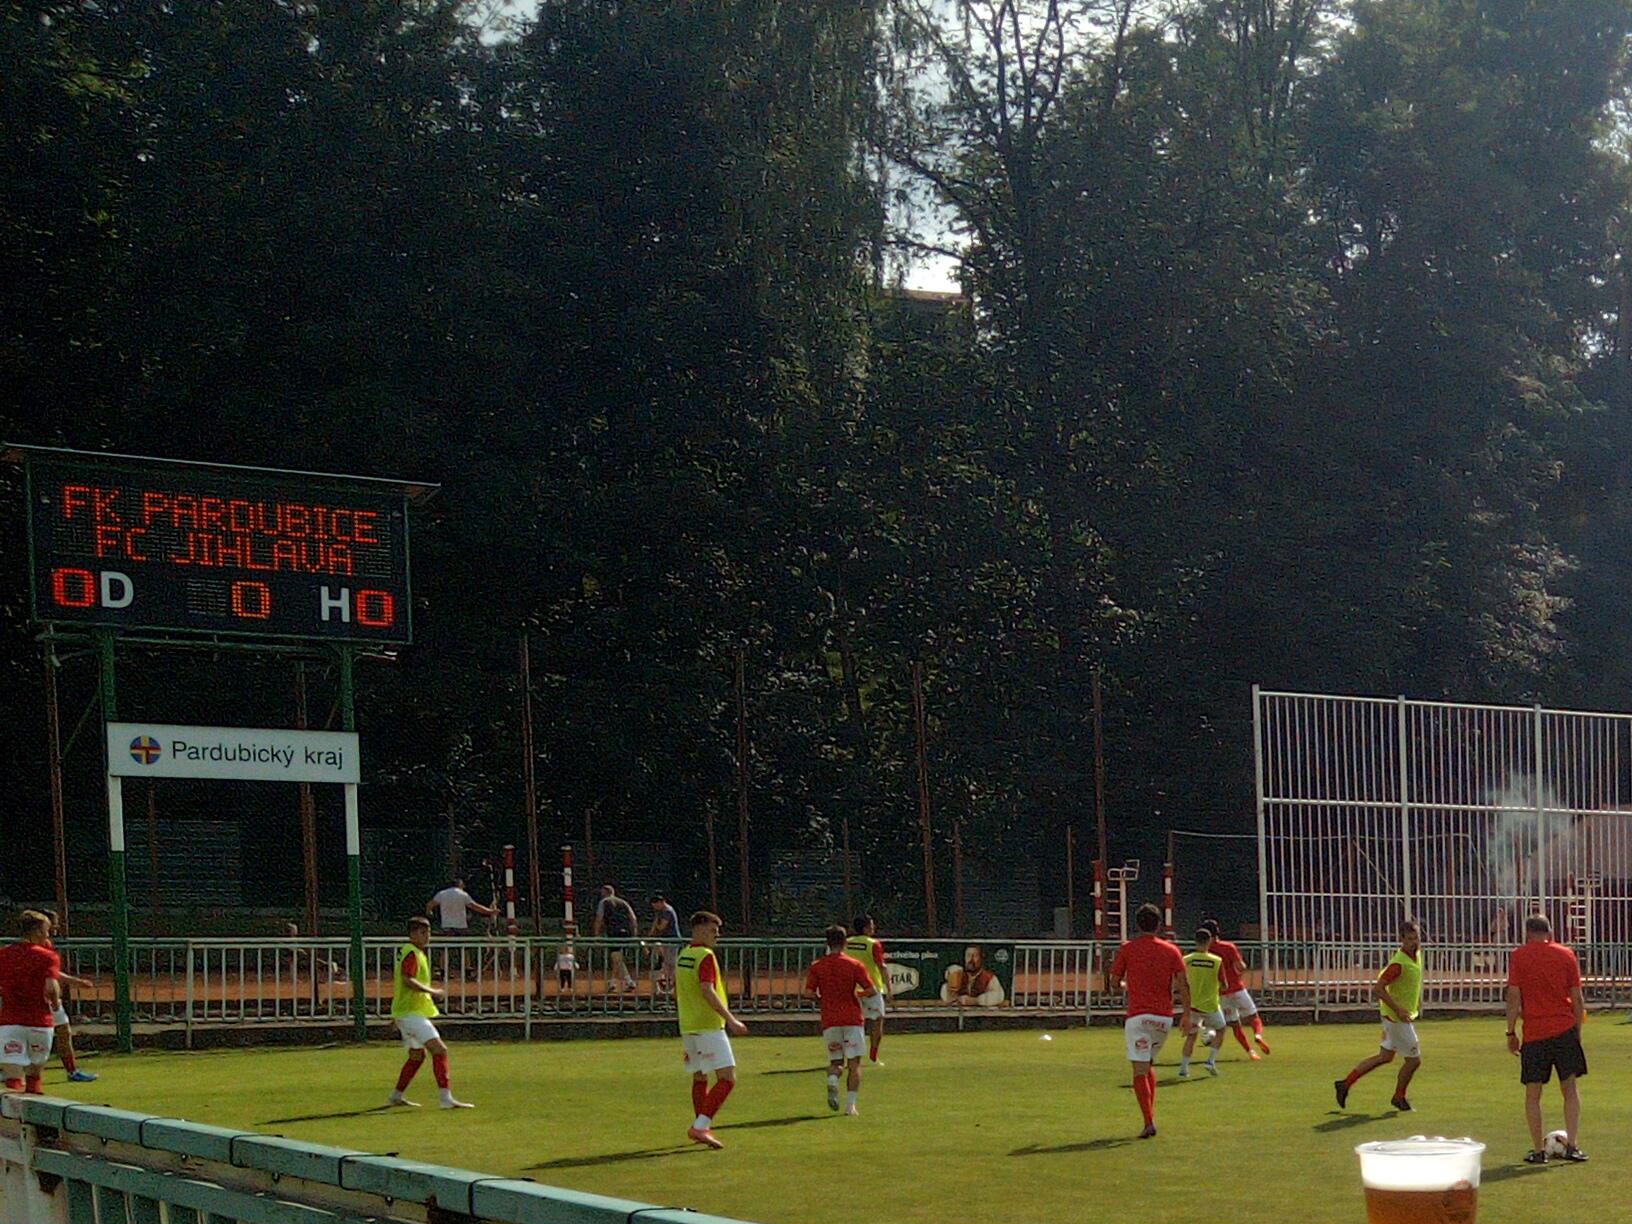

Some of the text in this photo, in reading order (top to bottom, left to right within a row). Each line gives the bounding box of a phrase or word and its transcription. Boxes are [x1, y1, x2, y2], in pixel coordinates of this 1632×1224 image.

[62, 485, 123, 523] FK
[96, 525, 354, 577] FC JIHLAVA
[171, 740, 343, 770] Pardubický kraj
